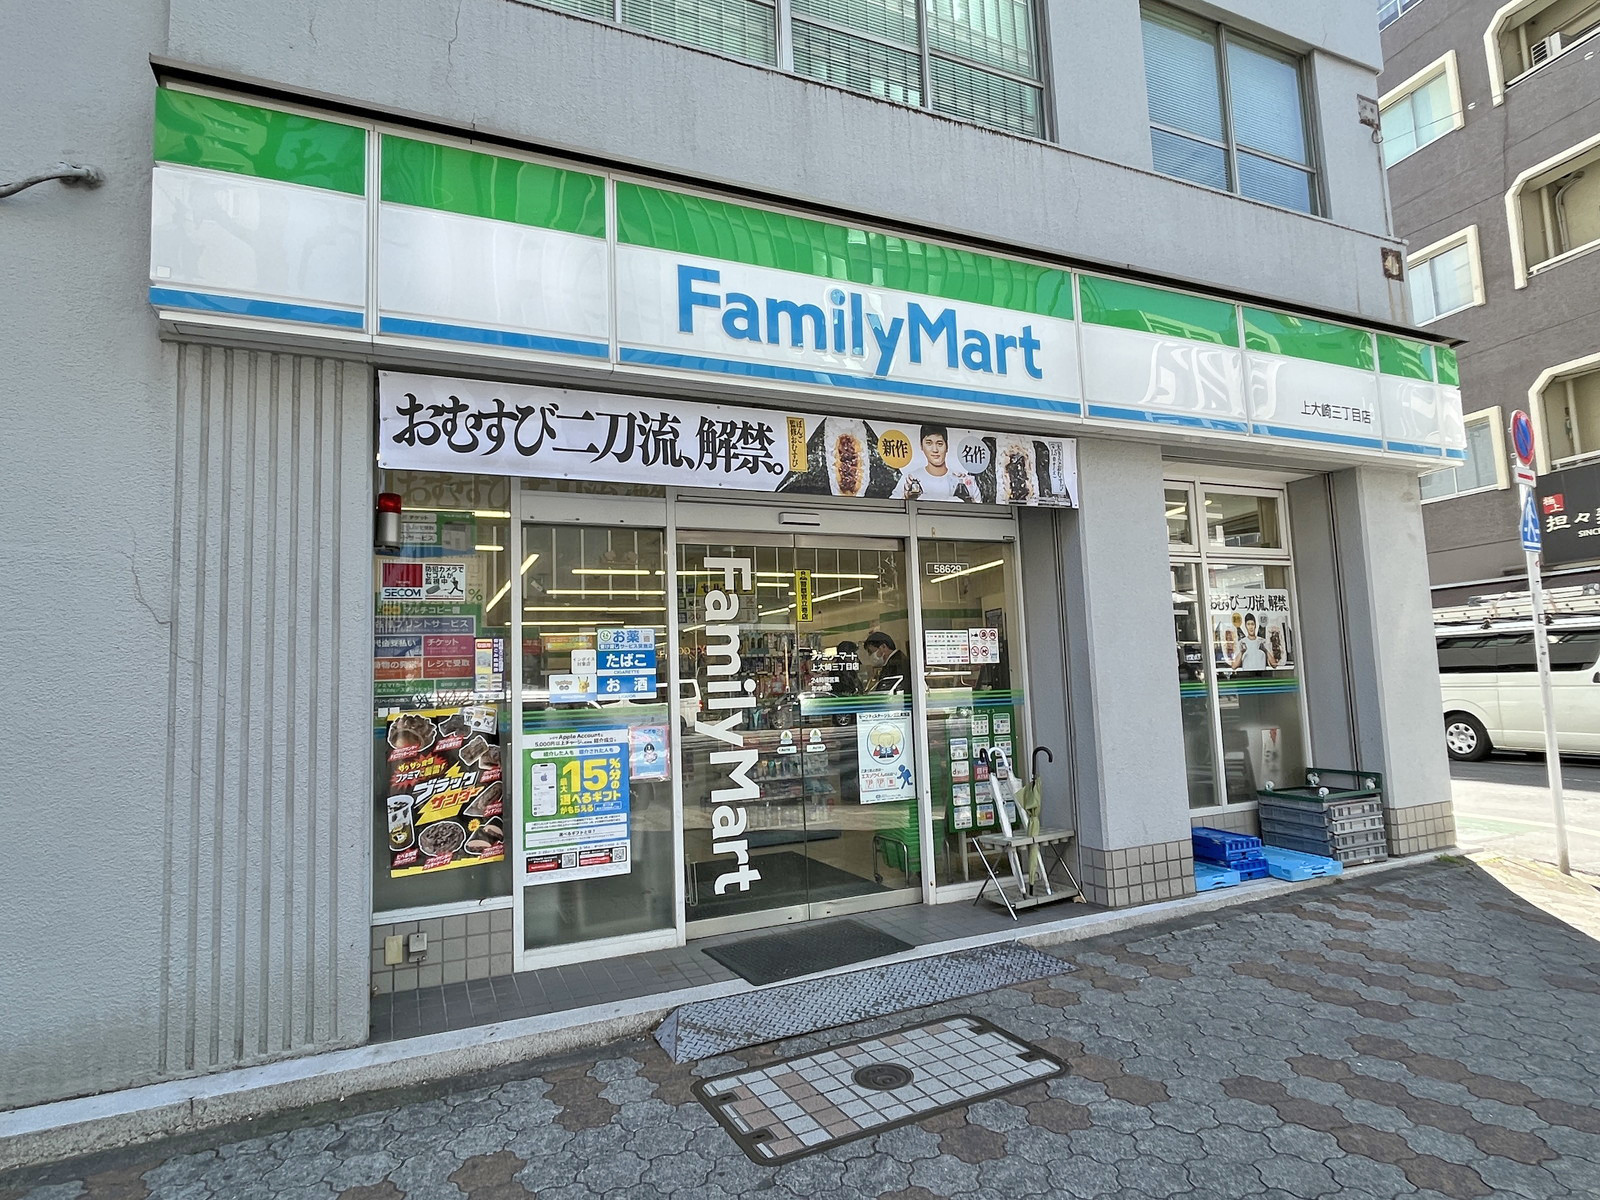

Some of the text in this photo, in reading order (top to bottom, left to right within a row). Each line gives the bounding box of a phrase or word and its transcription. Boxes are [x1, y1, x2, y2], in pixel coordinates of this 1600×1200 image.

[677, 264, 1043, 379] FamilyMart
[1300, 400, 1371, 424] 上大崎三丁目店
[392, 393, 784, 475] おむすび二刀流、解禁。
[882, 439, 909, 459] 新作
[961, 444, 986, 464] 名作
[1543, 496, 1564, 513] 極上
[1546, 508, 1600, 533] 担々
[1578, 528, 1600, 538] SINC
[933, 564, 962, 574] 58629
[384, 588, 421, 597] SECOM
[427, 638, 459, 646] チケット
[613, 630, 640, 643] お薬
[427, 660, 470, 668] レジで受取
[606, 653, 647, 667] たばこ
[811, 662, 860, 671] 上大崎三丁目店
[606, 677, 648, 692] お酒
[695, 557, 762, 895] FamilyMart
[562, 759, 608, 793] 15
[413, 771, 479, 806] ブラック
[430, 786, 485, 810] サンダー
[560, 791, 621, 805] 選べるギフト
[560, 804, 594, 815] がもらえる
